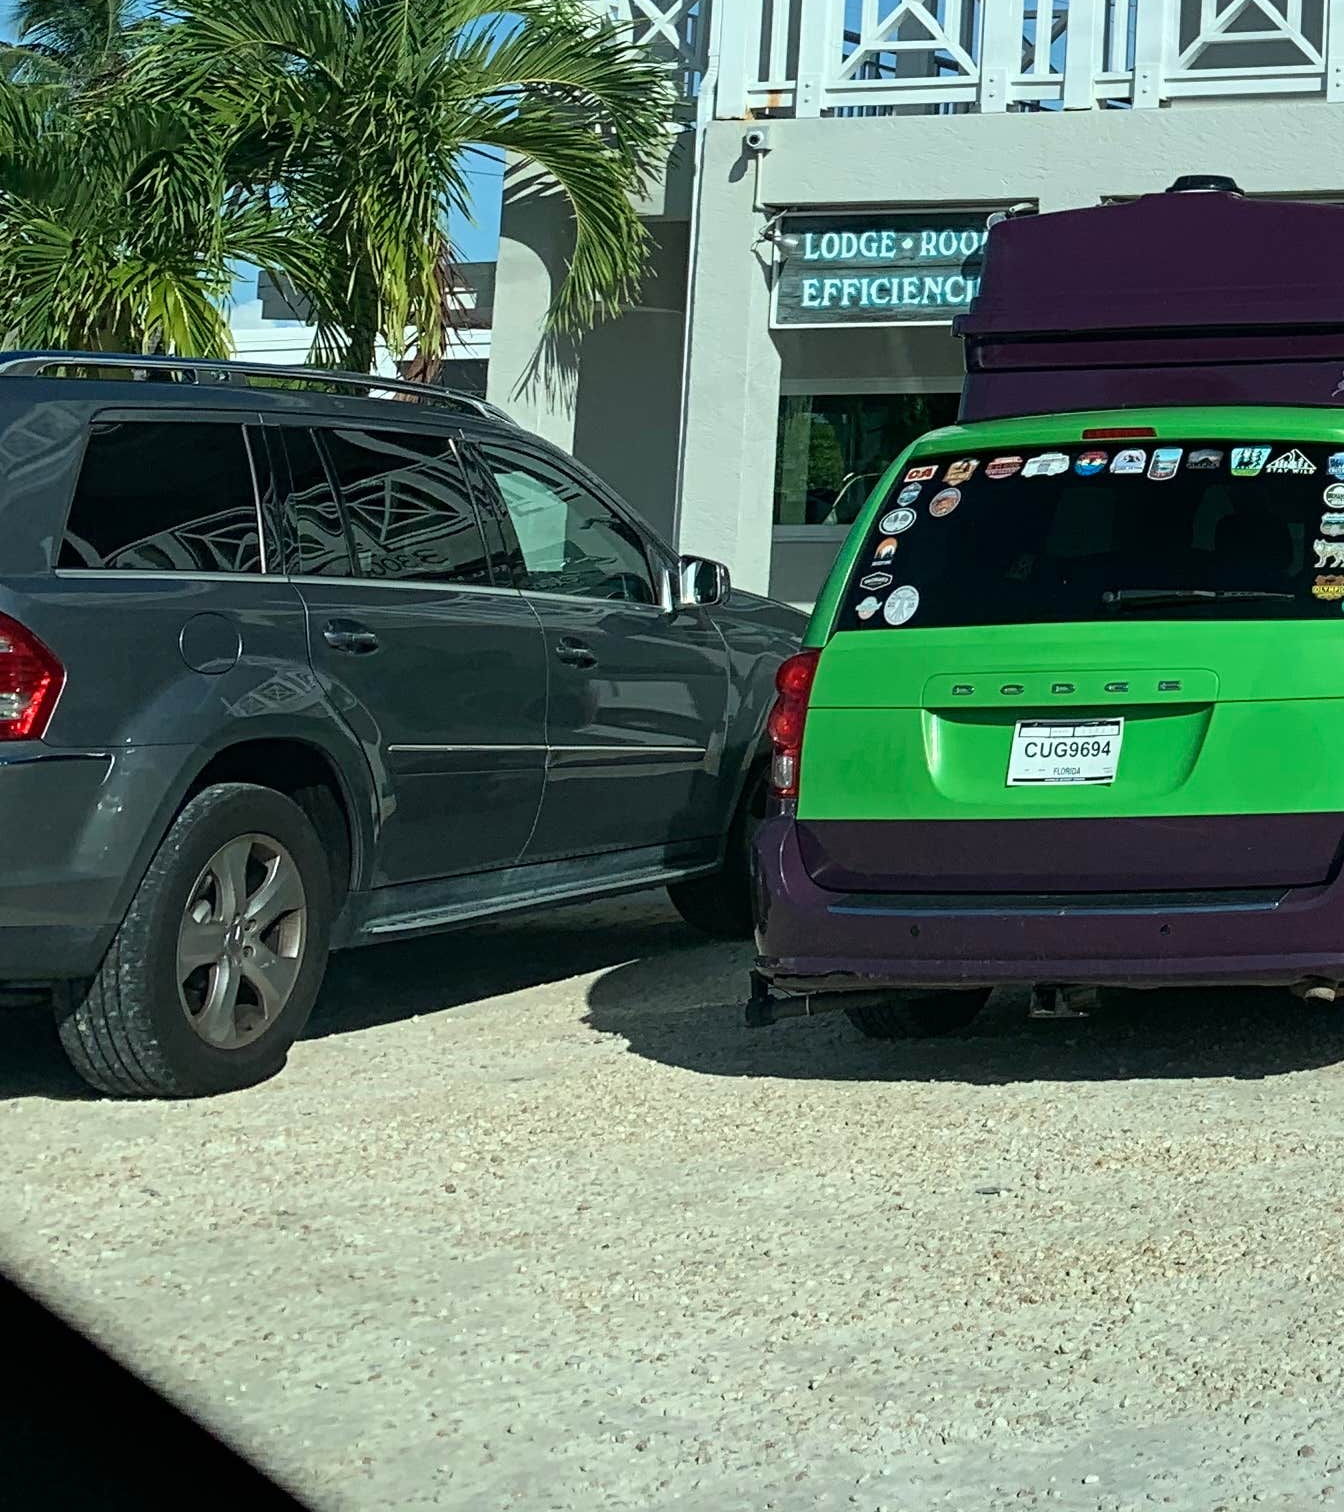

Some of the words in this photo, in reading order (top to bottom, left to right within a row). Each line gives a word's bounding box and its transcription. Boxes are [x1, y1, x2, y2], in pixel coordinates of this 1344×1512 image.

[803, 231, 897, 261] LODGE
[919, 229, 989, 257] ROO
[952, 680, 1182, 696] DODGE
[1024, 740, 1112, 758] CUG9694
[1053, 767, 1081, 776] FLORIDA
